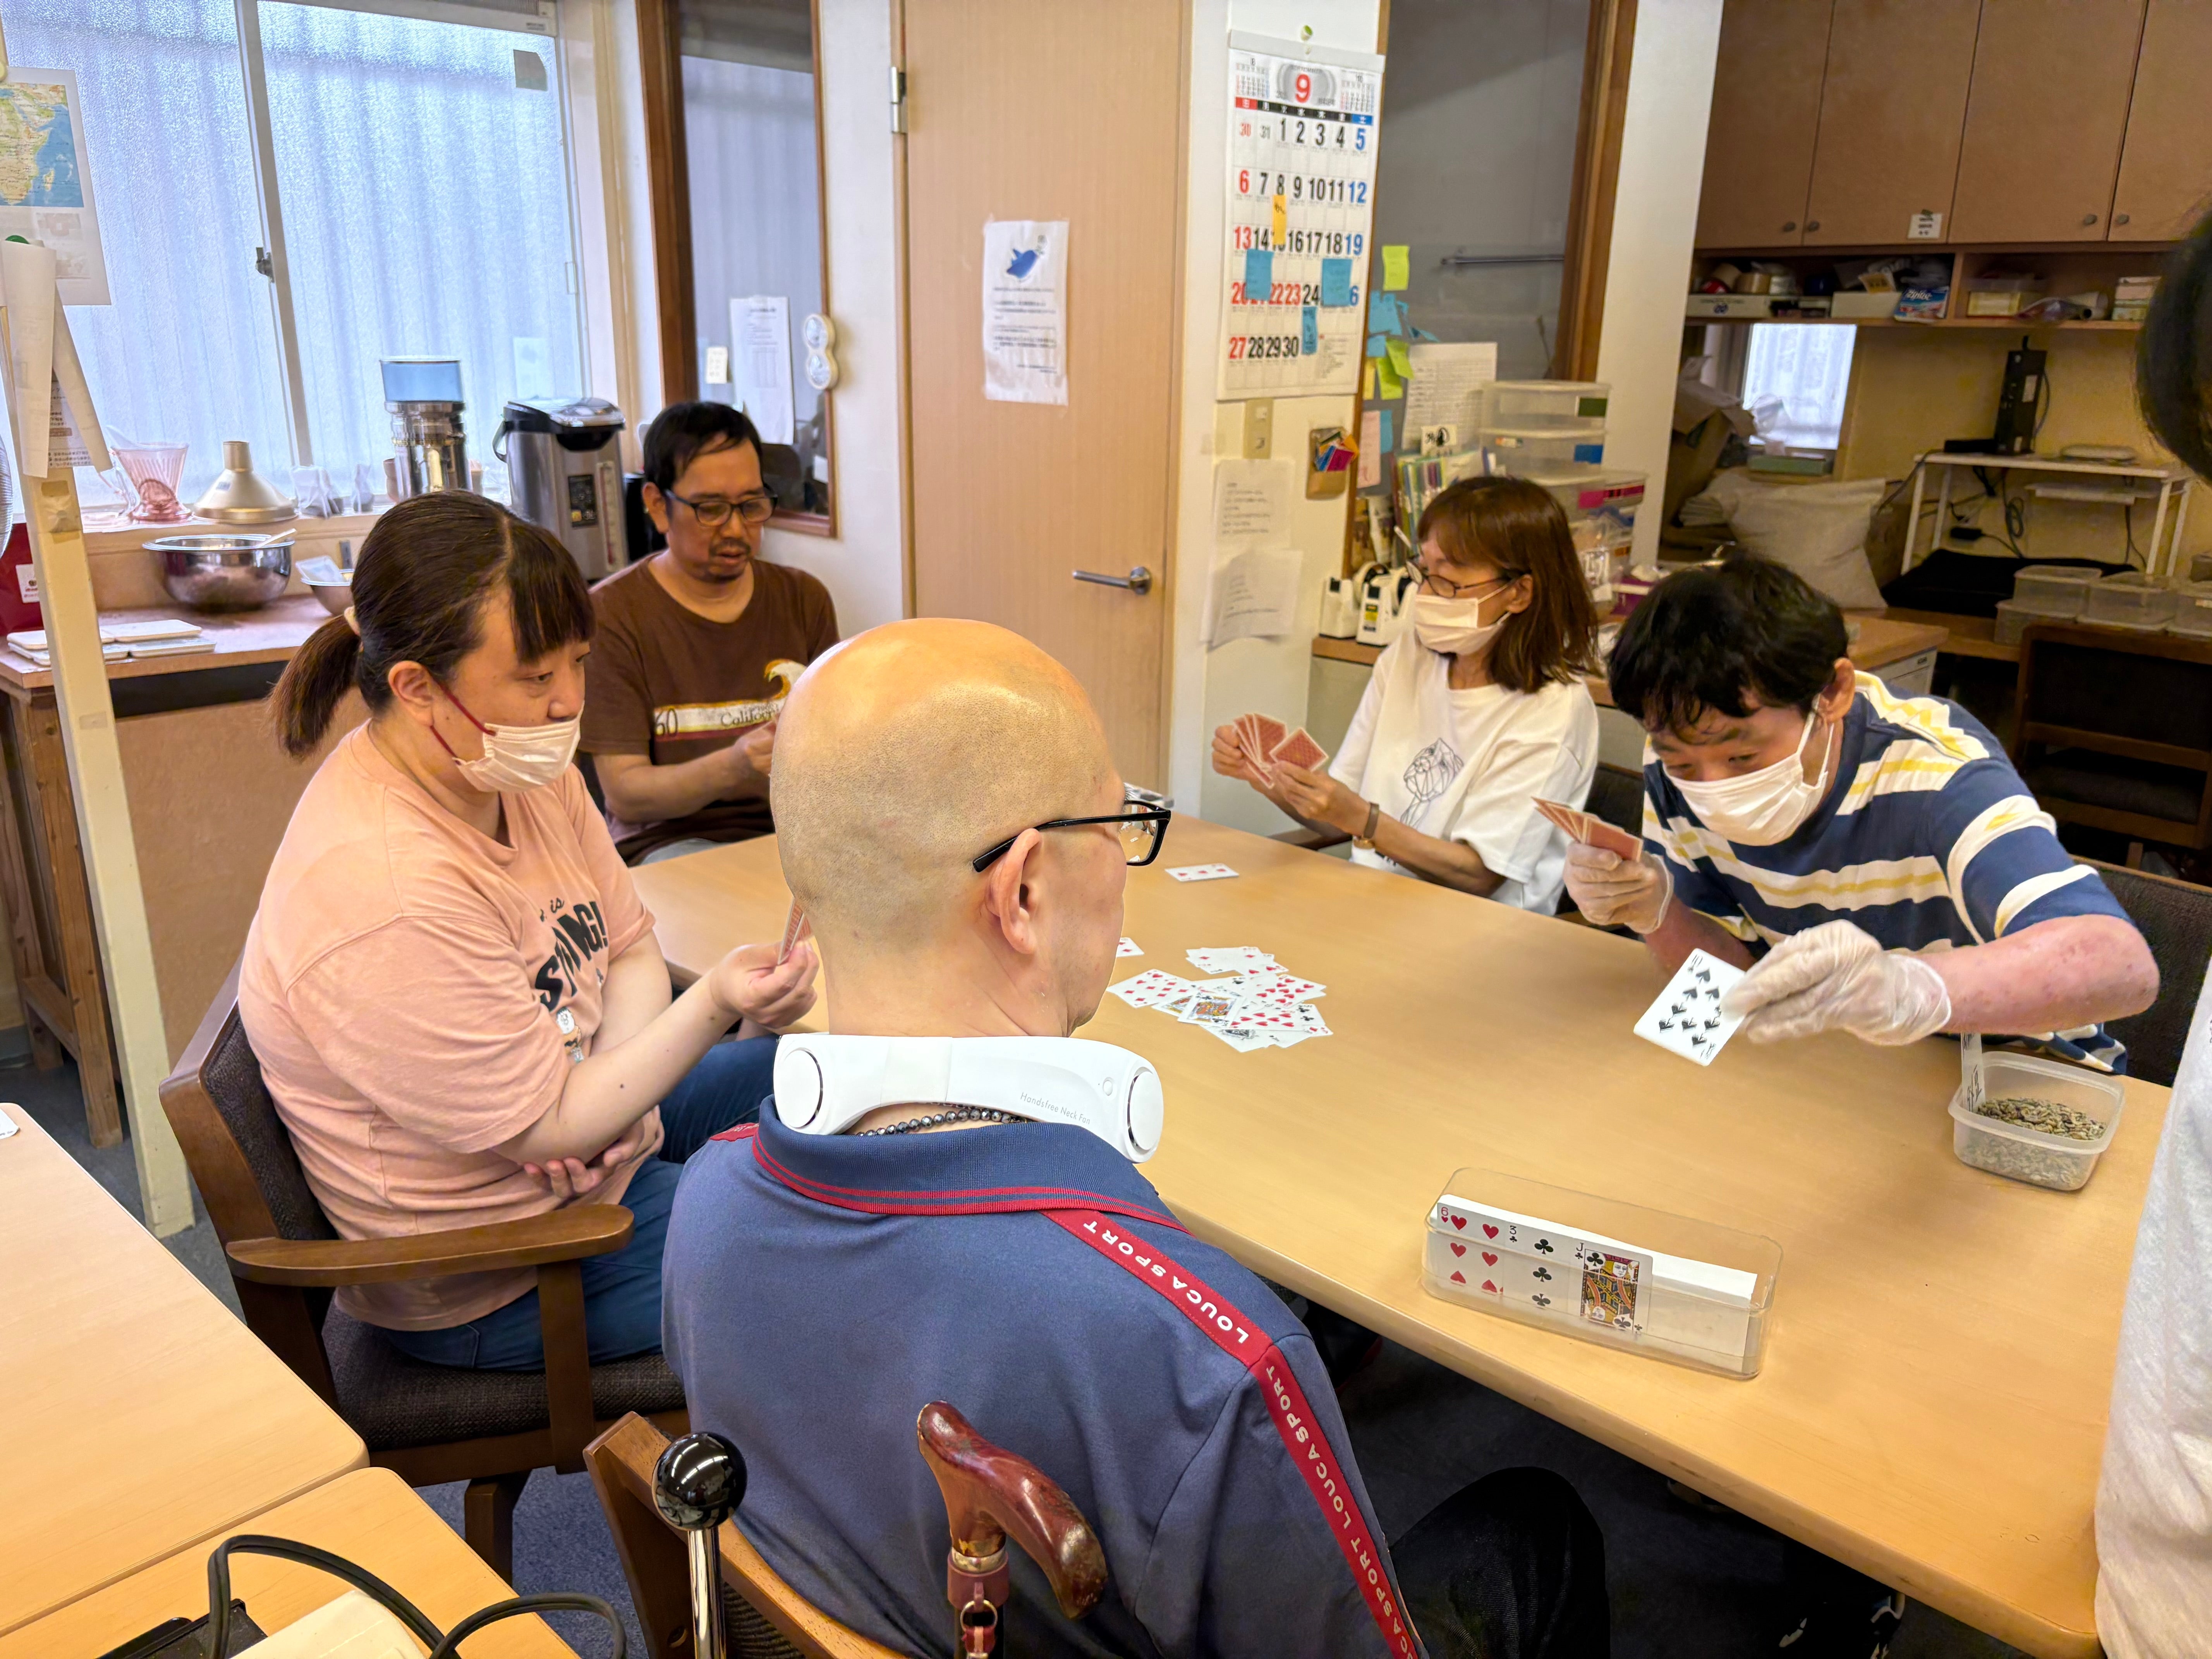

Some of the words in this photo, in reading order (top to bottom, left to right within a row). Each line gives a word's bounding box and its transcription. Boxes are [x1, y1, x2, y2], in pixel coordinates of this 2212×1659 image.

[1295, 74, 1311, 103] 9
[1240, 123, 1251, 137] 30
[1260, 126, 1271, 139] 31
[1281, 117, 1286, 141] 1
[1297, 121, 1305, 144] 2
[1316, 123, 1326, 146] 3
[1336, 126, 1345, 148] 4
[1356, 128, 1366, 151] 5
[1240, 170, 1250, 194] 6
[1260, 172, 1269, 195] 7
[1276, 174, 1285, 195] 8
[1293, 176, 1302, 199] 9
[1309, 178, 1327, 201] 10
[1328, 179, 1345, 202] 11
[1349, 181, 1367, 204] 12
[1234, 226, 1252, 250] 13
[1254, 227, 1269, 251] 14
[1288, 231, 1303, 252] 16
[1307, 232, 1322, 254] 17
[1326, 232, 1343, 254] 18
[1345, 234, 1363, 255] 19
[1285, 283, 1301, 305] 23
[1302, 284, 1320, 306] 24
[1349, 285, 1359, 306] 6
[1228, 337, 1247, 359] 27
[1248, 336, 1264, 358] 28
[1265, 336, 1281, 357] 29
[1281, 336, 1299, 357] 30
[1020, 1092, 1059, 1113] Handsfree
[1060, 1107, 1077, 1120] Neck
[1079, 1113, 1091, 1125] Fan
[1441, 1206, 1449, 1216] 6
[1509, 1225, 1517, 1235] 3
[1083, 1220, 1167, 1277] SPORT
[1575, 1242, 1584, 1252] J
[1172, 1275, 1249, 1345] LOUCA
[1266, 1365, 1309, 1444] SPORT
[1308, 1442, 1352, 1529] LOUCA
[1350, 1536, 1393, 1618] SPORT
